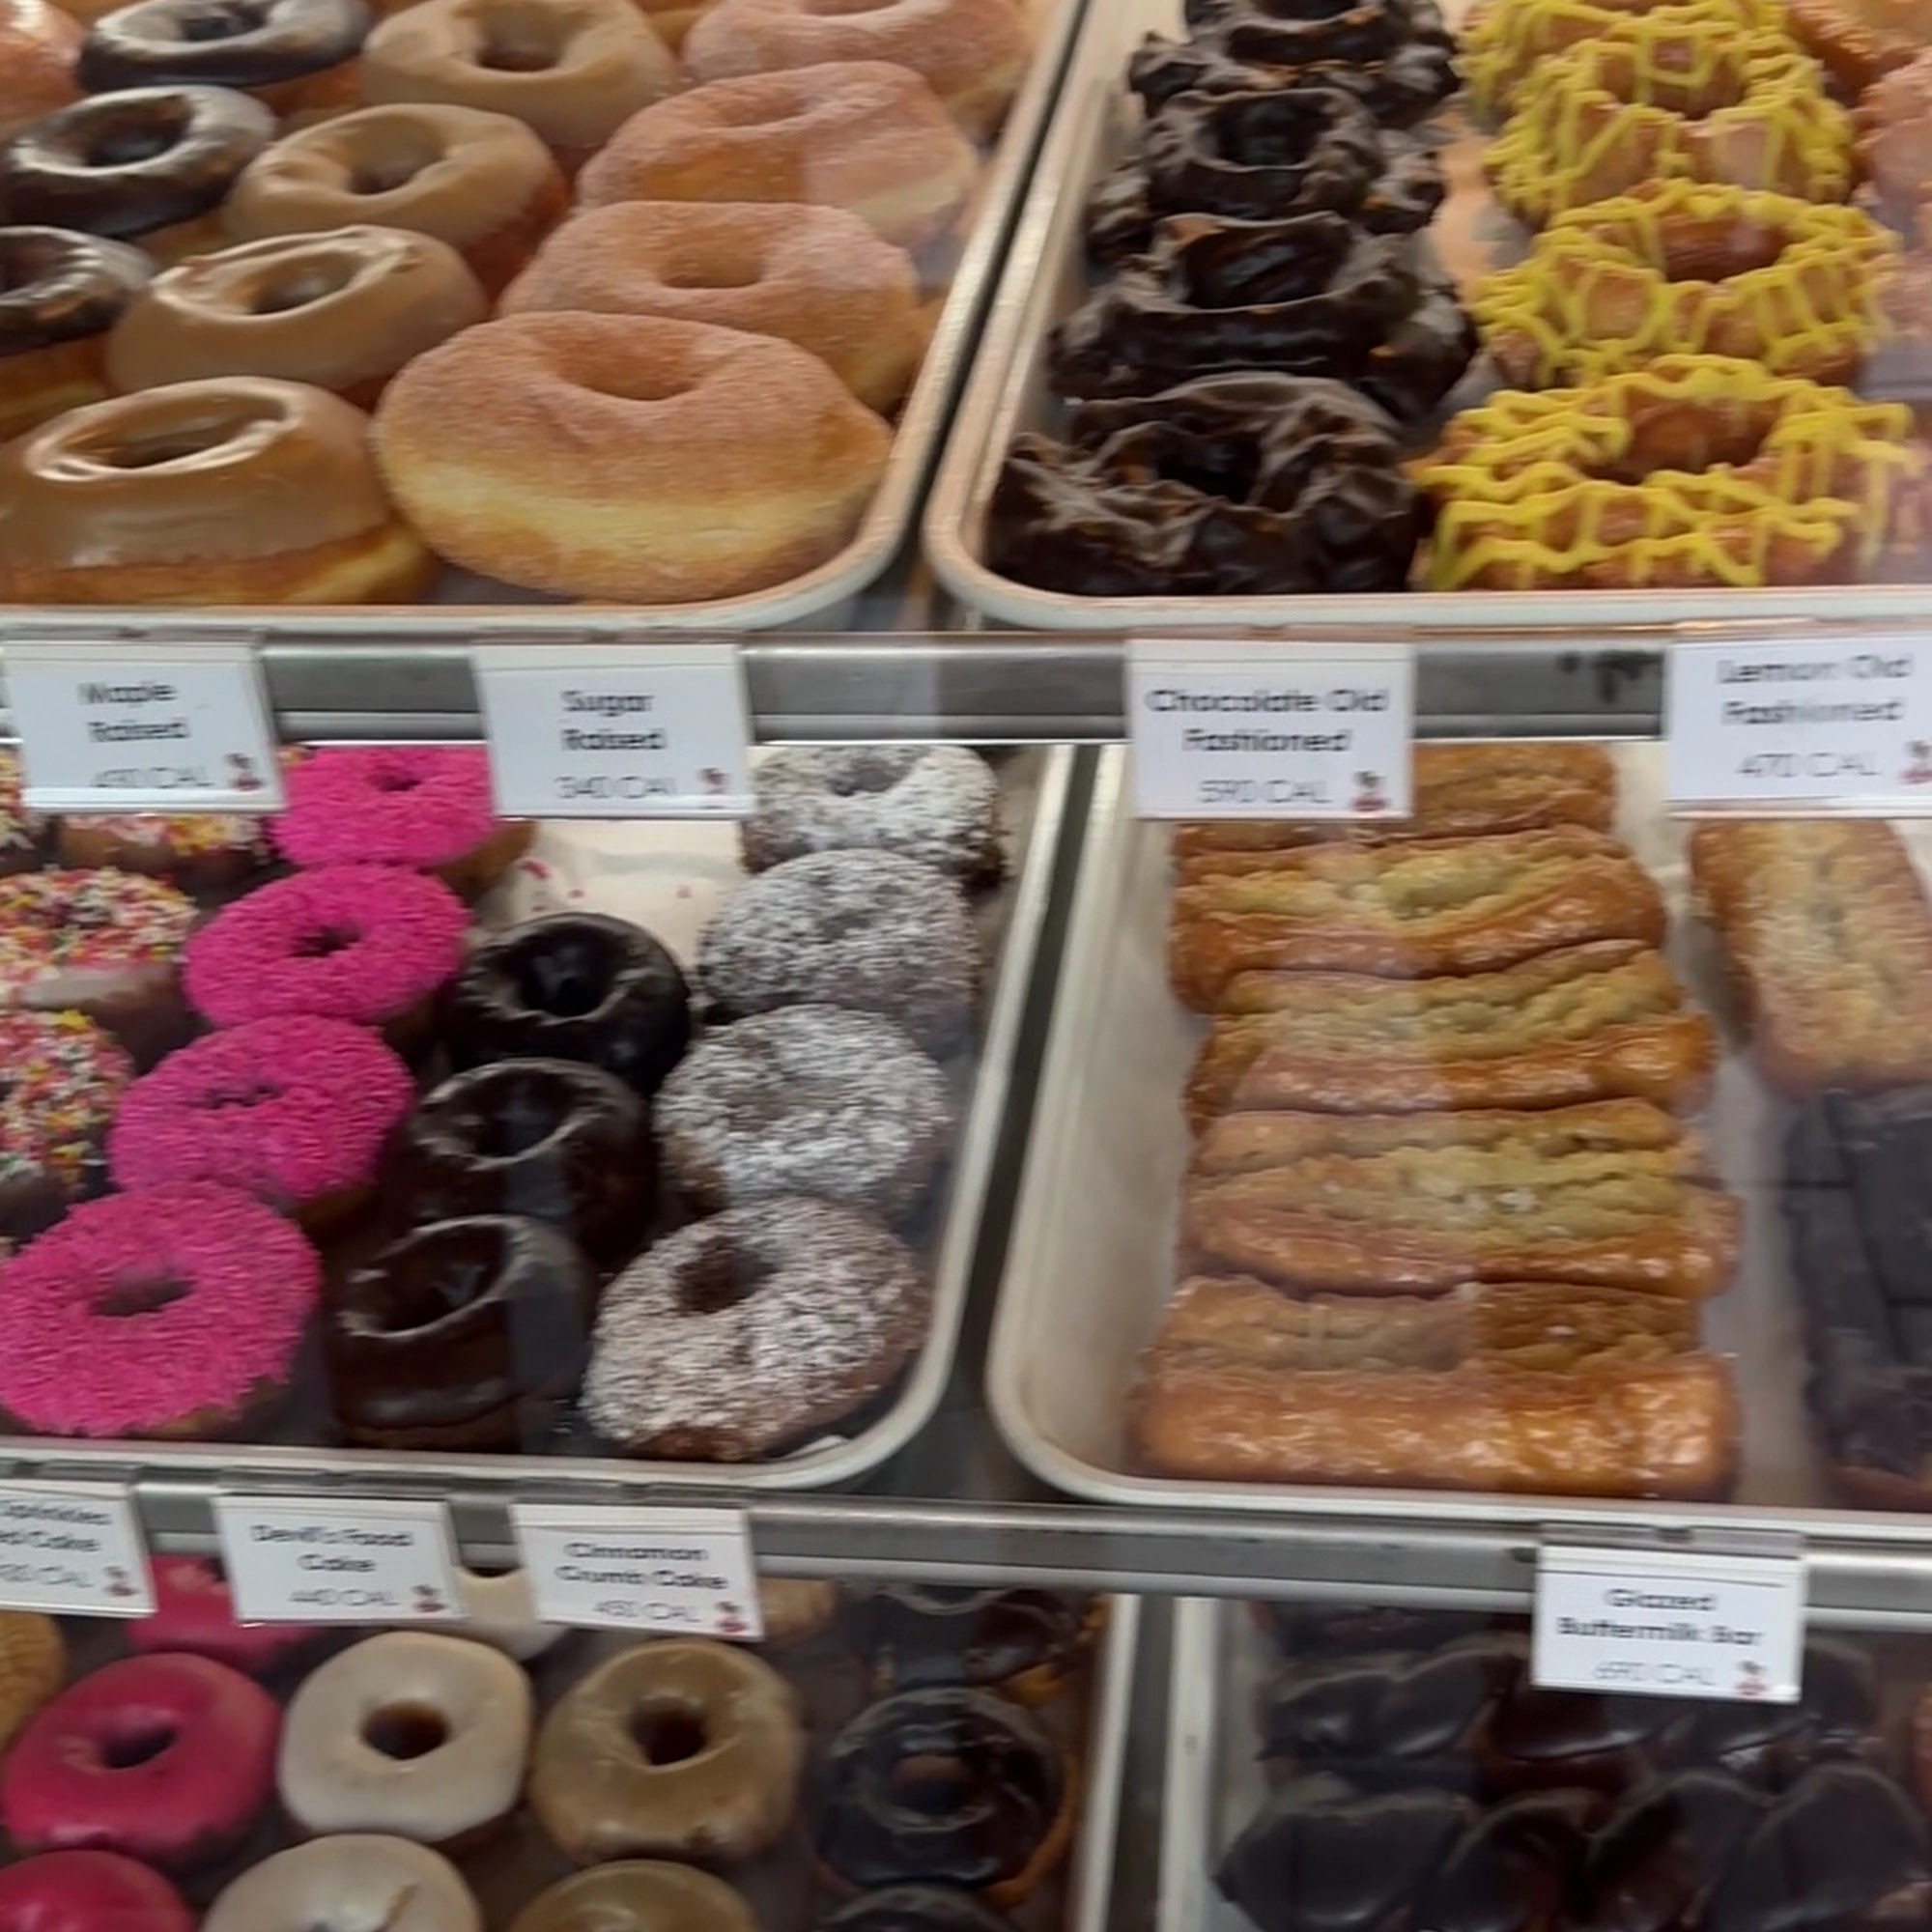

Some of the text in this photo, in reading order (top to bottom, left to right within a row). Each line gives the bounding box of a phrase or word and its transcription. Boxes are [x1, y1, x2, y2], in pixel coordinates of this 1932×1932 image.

[1718, 653, 1915, 684] Lemon Old
[560, 690, 654, 717] Sugar
[1145, 688, 1390, 712] Chocolate Old
[1720, 697, 1908, 725] Fashioned
[1181, 728, 1351, 752] Fashioned
[563, 1542, 709, 1562] Cinnamon
[554, 1565, 729, 1590] Crumb Cake
[1604, 1588, 1717, 1611] Glazed
[1556, 1616, 1764, 1646] Buttermilk Bar
